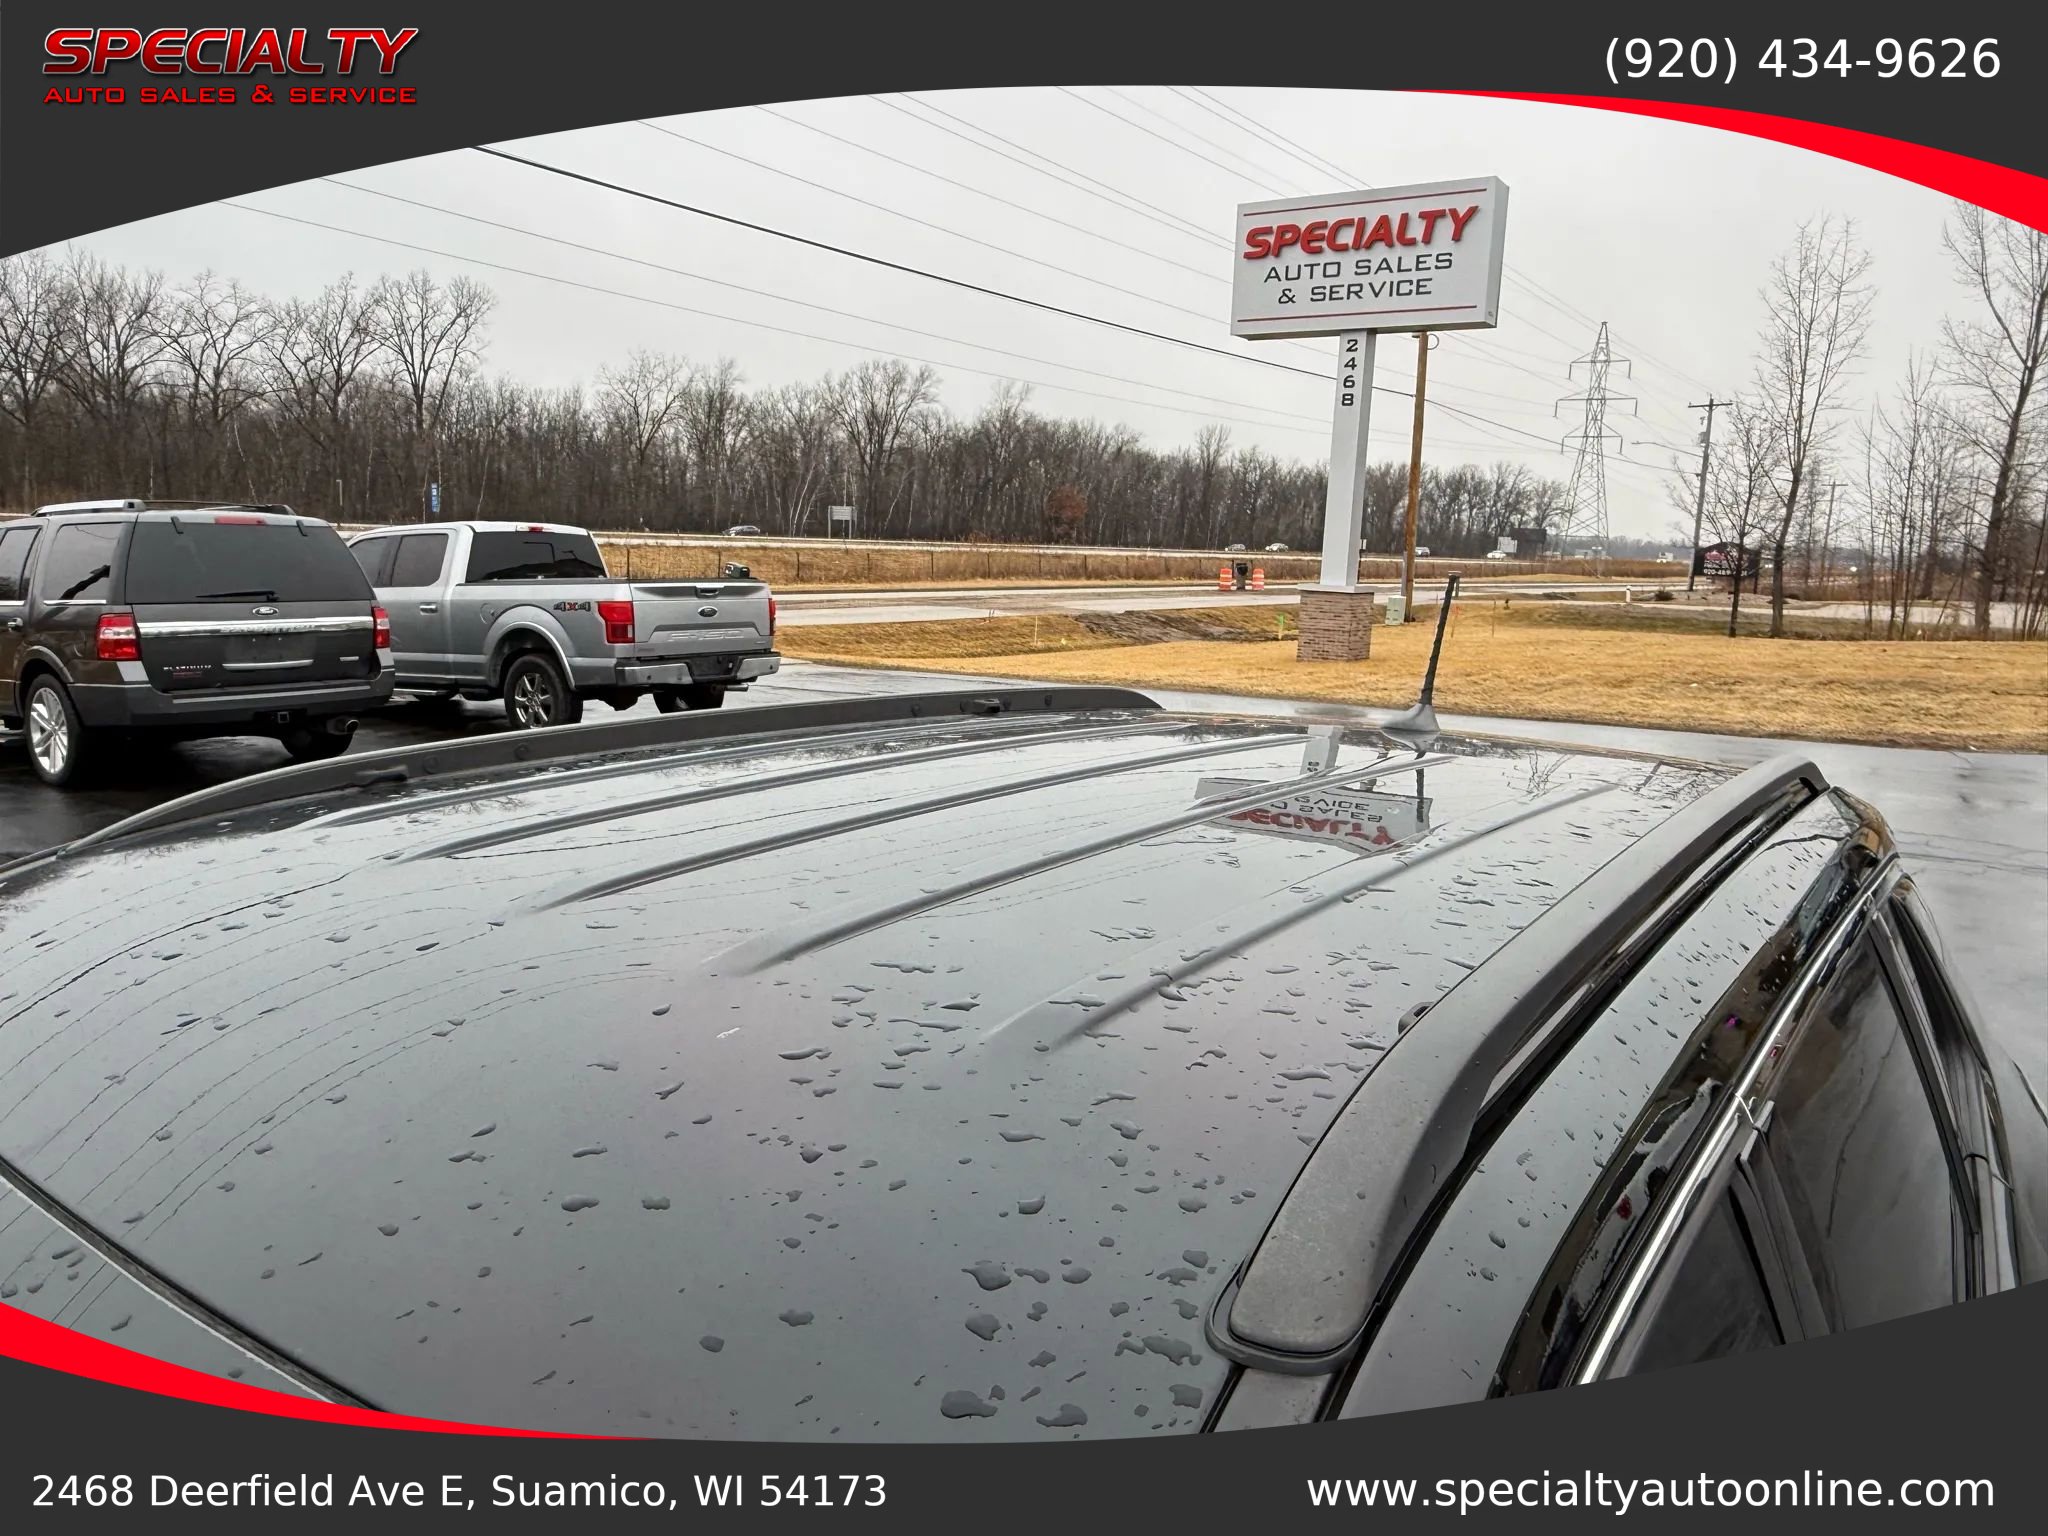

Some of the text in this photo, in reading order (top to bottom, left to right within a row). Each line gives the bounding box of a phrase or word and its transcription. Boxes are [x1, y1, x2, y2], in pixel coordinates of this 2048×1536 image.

[1243, 205, 1480, 260] SPECIALTY
[1263, 252, 1454, 283] AUTO SALES
[1278, 277, 1434, 305] & SERVICE
